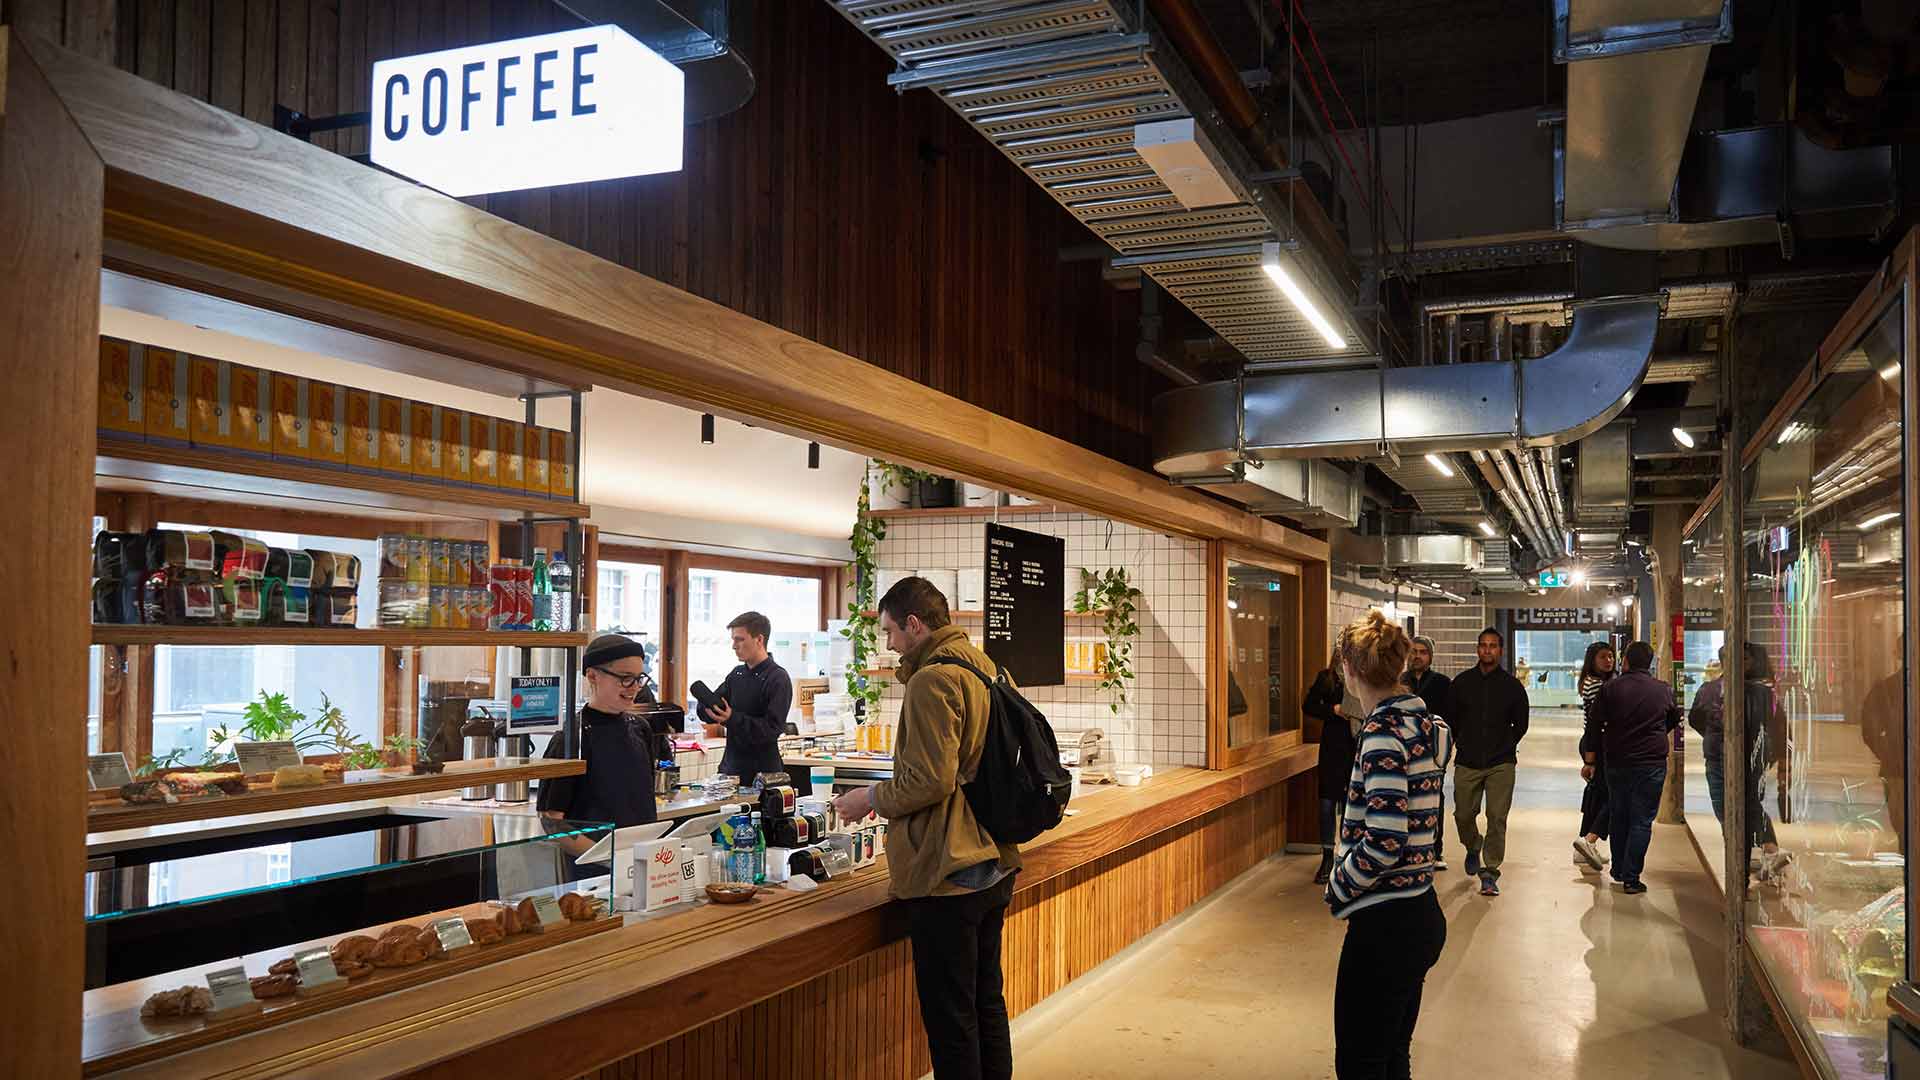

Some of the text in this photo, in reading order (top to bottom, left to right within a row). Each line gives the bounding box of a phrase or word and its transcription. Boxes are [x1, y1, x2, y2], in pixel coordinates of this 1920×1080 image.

[384, 44, 598, 141] COFFEE
[519, 677, 553, 688] TODAY ONLY!
[655, 846, 675, 867] skip
